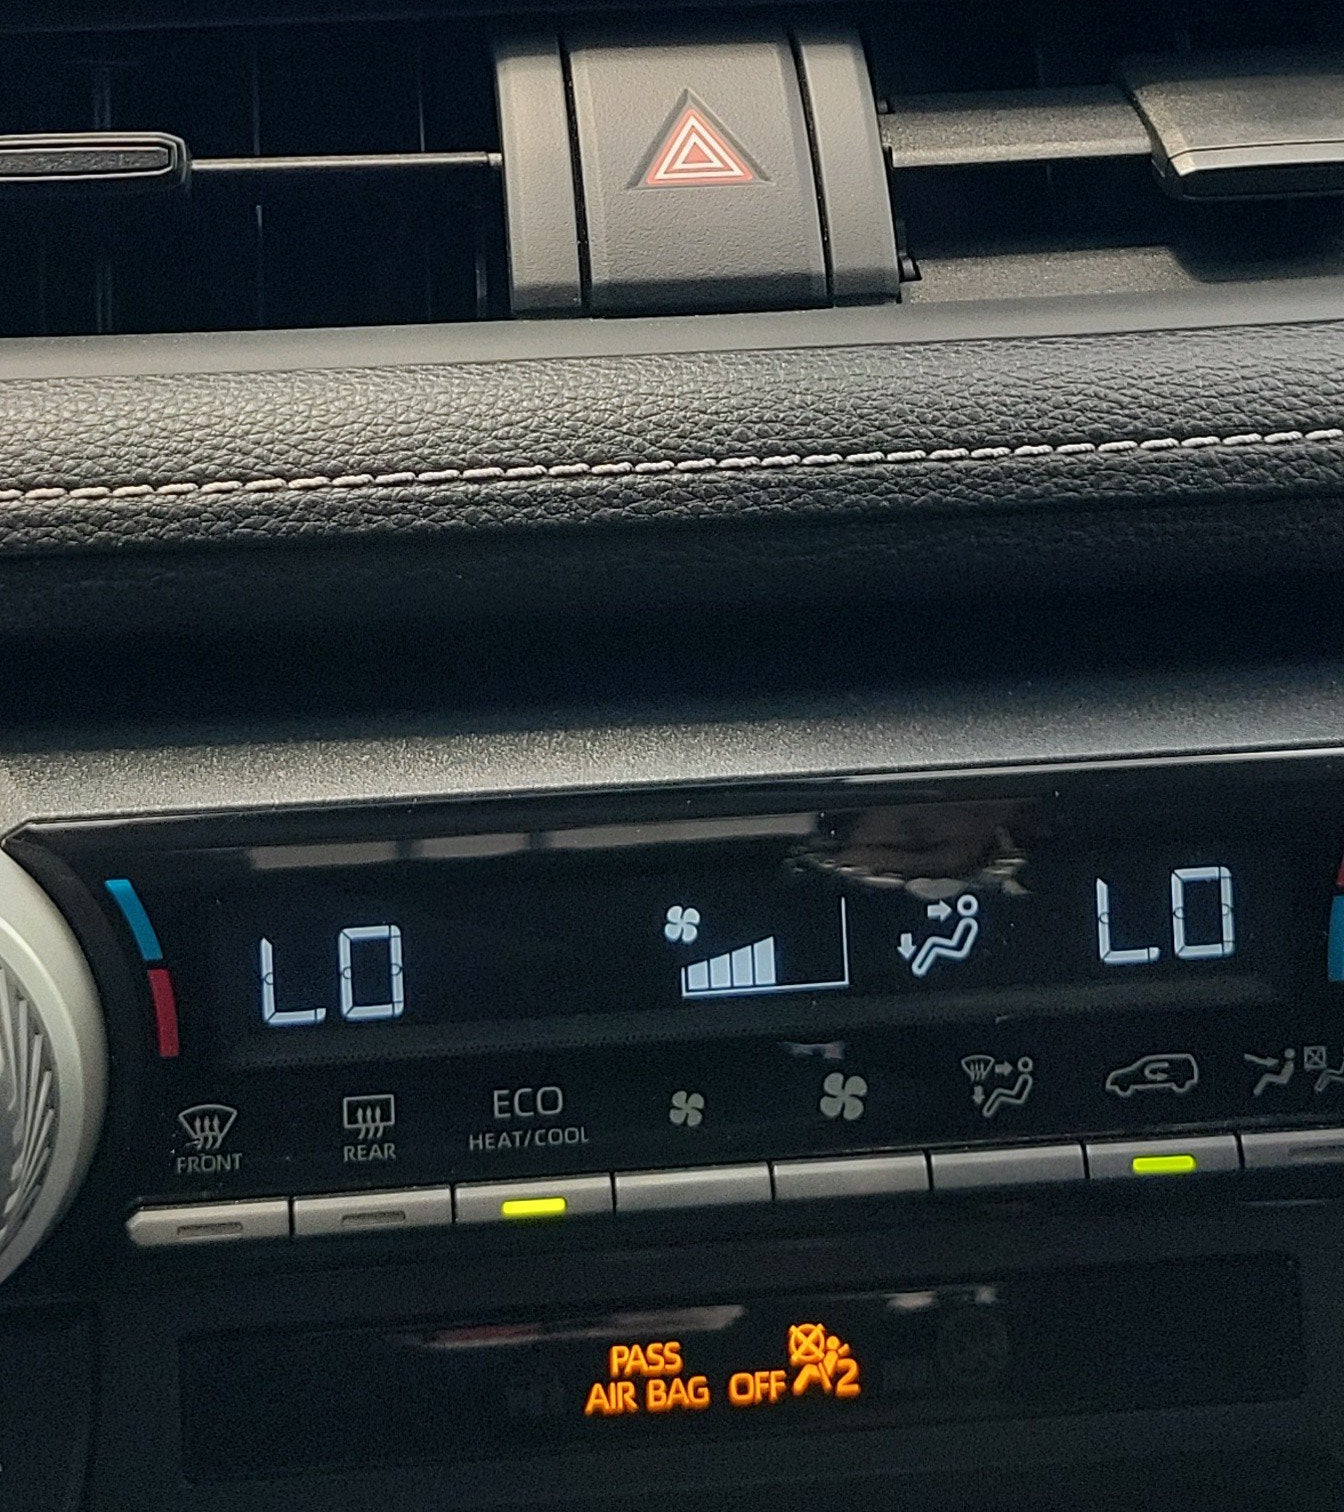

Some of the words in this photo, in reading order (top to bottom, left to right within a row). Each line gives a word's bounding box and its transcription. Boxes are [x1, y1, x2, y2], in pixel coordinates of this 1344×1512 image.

[1094, 864, 1236, 964] LO
[259, 923, 405, 1027] LO
[493, 1085, 565, 1118] ECO
[343, 1143, 397, 1162] REAR
[468, 1126, 589, 1152] HEAT/COOL
[176, 1150, 244, 1174] FRONT
[608, 1340, 684, 1379] PASS
[584, 1379, 640, 1417] AIR
[645, 1374, 711, 1413] BAG
[727, 1368, 788, 1406] OFF
